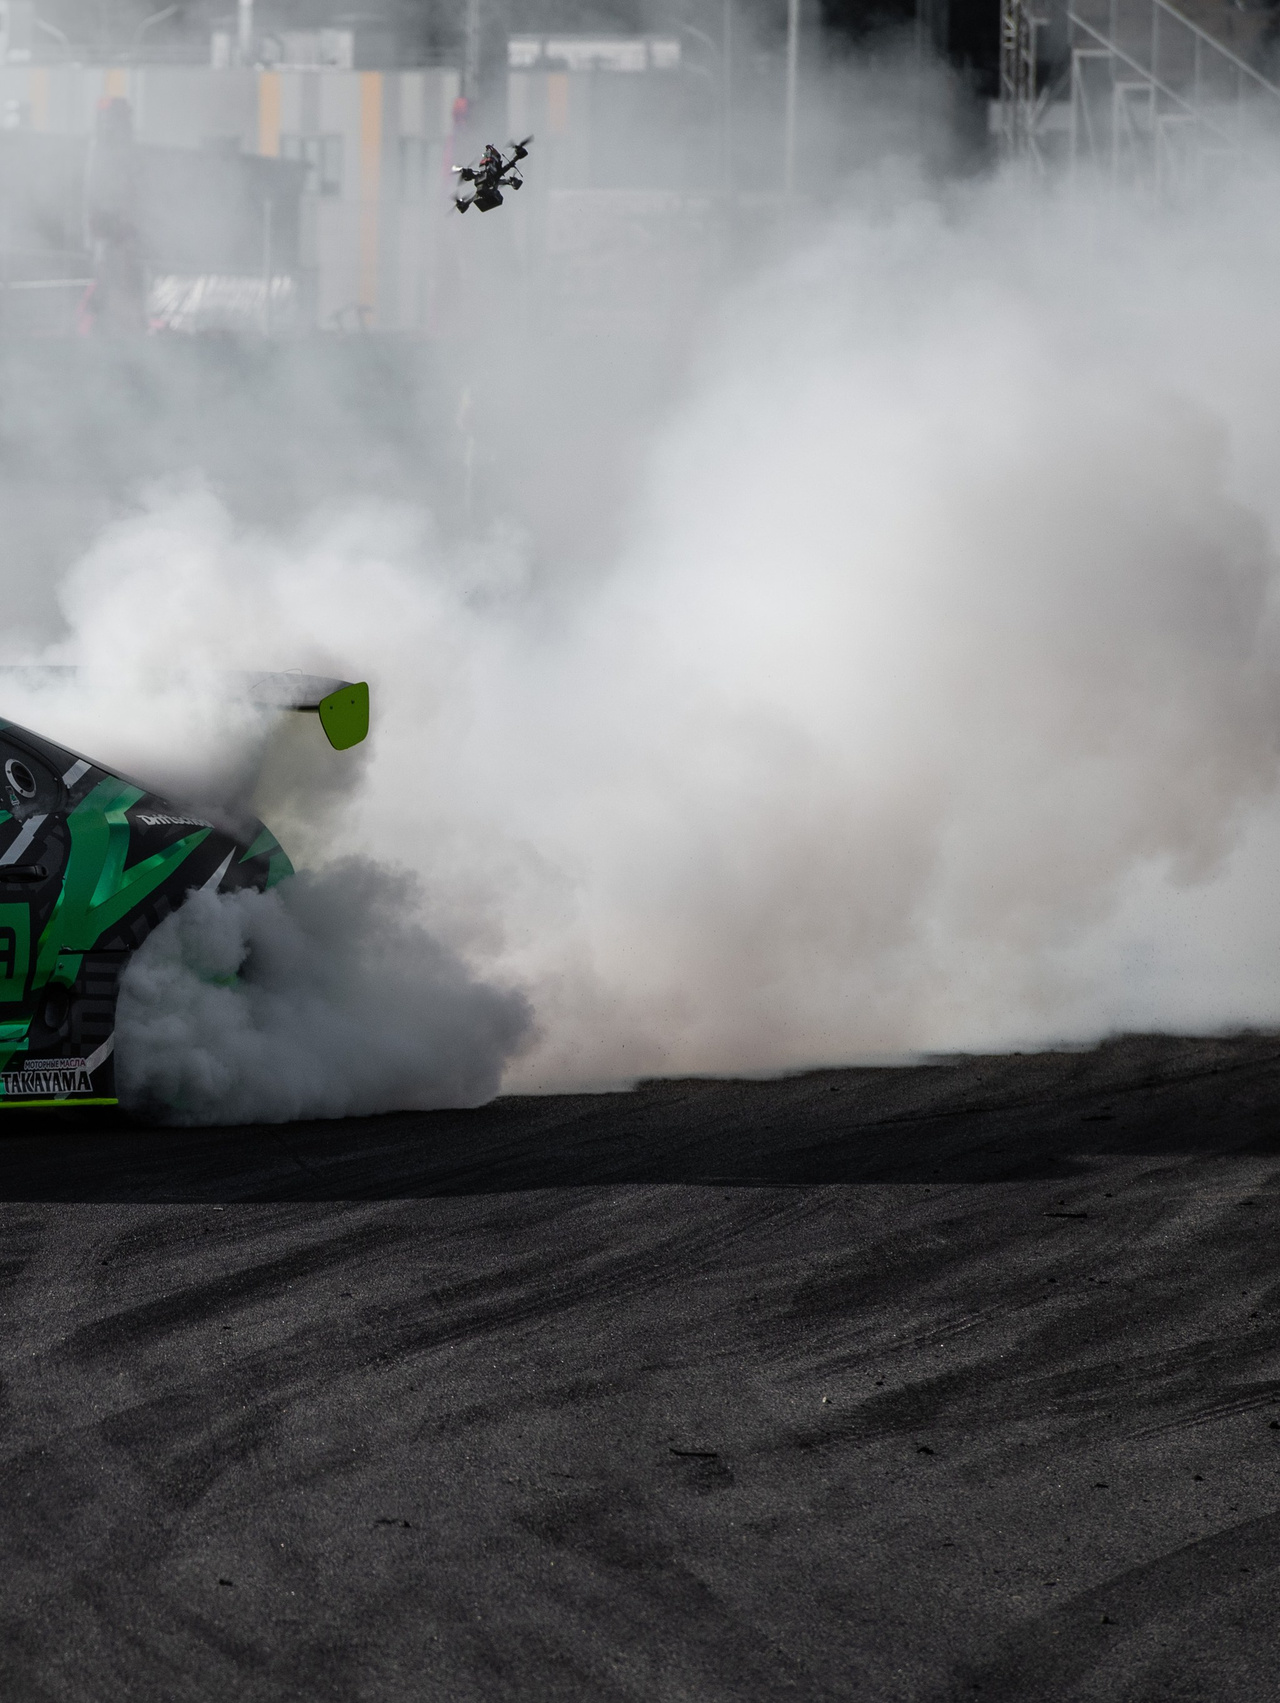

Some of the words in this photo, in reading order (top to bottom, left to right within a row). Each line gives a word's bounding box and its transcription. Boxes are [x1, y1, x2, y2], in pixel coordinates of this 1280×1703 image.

[24, 1059, 59, 1070] МОТОРНЫЕ
[60, 1058, 87, 1069] МАСЛА
[1, 1070, 93, 1094] TAKAYAMA
